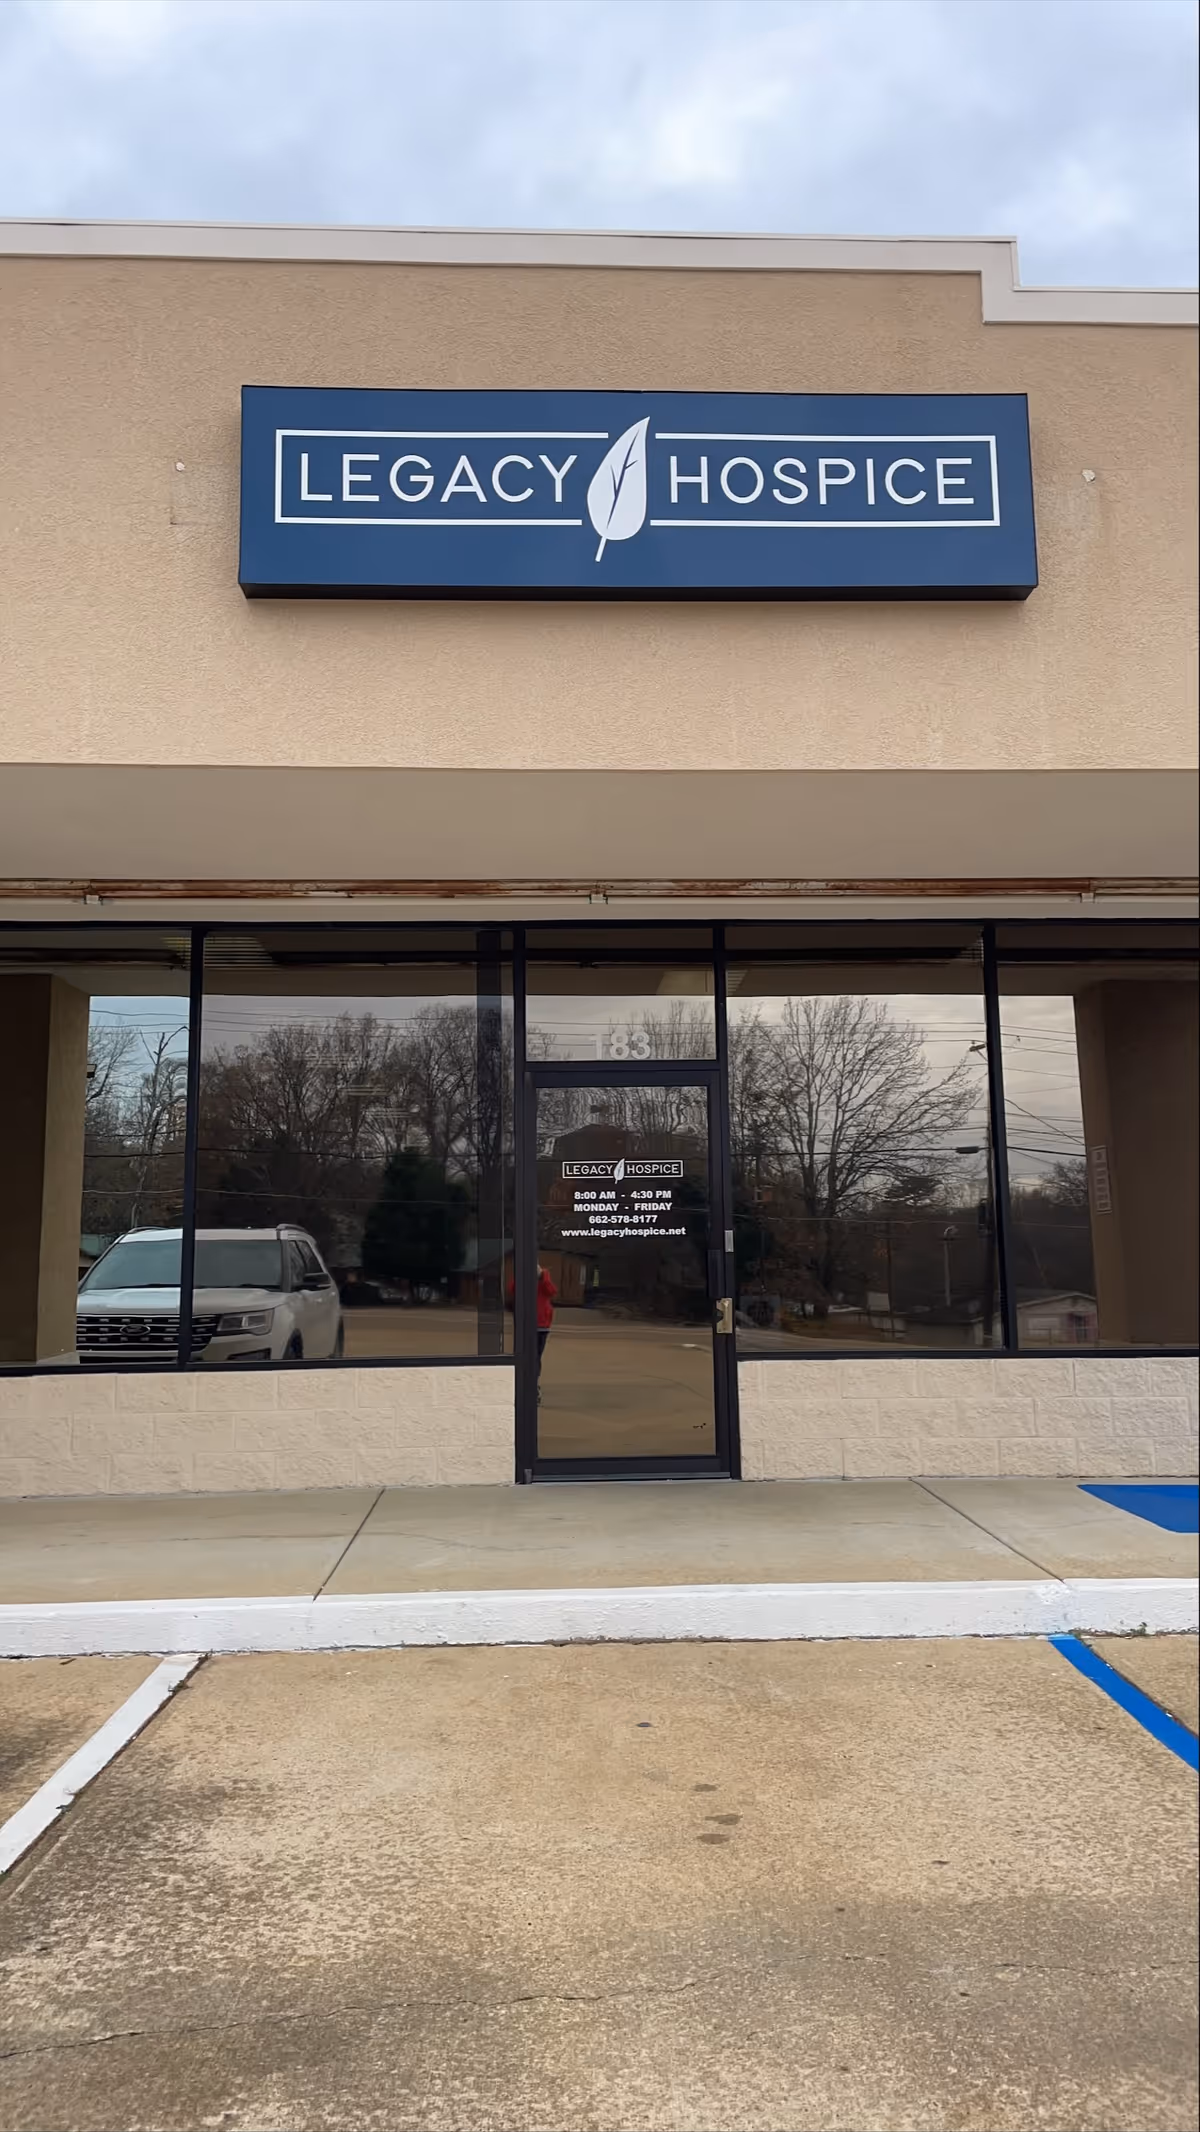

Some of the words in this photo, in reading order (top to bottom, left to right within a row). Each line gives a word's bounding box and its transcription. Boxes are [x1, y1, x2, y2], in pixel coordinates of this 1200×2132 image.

[299, 452, 578, 504] LEGACY
[670, 456, 975, 506] HOSPICE
[589, 1031, 651, 1060] 183
[566, 1165, 613, 1175] LEGACY
[626, 1164, 680, 1174] HOSPICE
[574, 1191, 597, 1200] 8:00
[599, 1191, 616, 1199] AM
[630, 1190, 653, 1199] 4:30
[655, 1190, 672, 1199] PM
[573, 1203, 620, 1212] MONDAY
[634, 1202, 673, 1211] FRIDAY
[588, 1215, 658, 1224] 662-578-8177
[561, 1227, 686, 1237] www.legacyhospice.net
